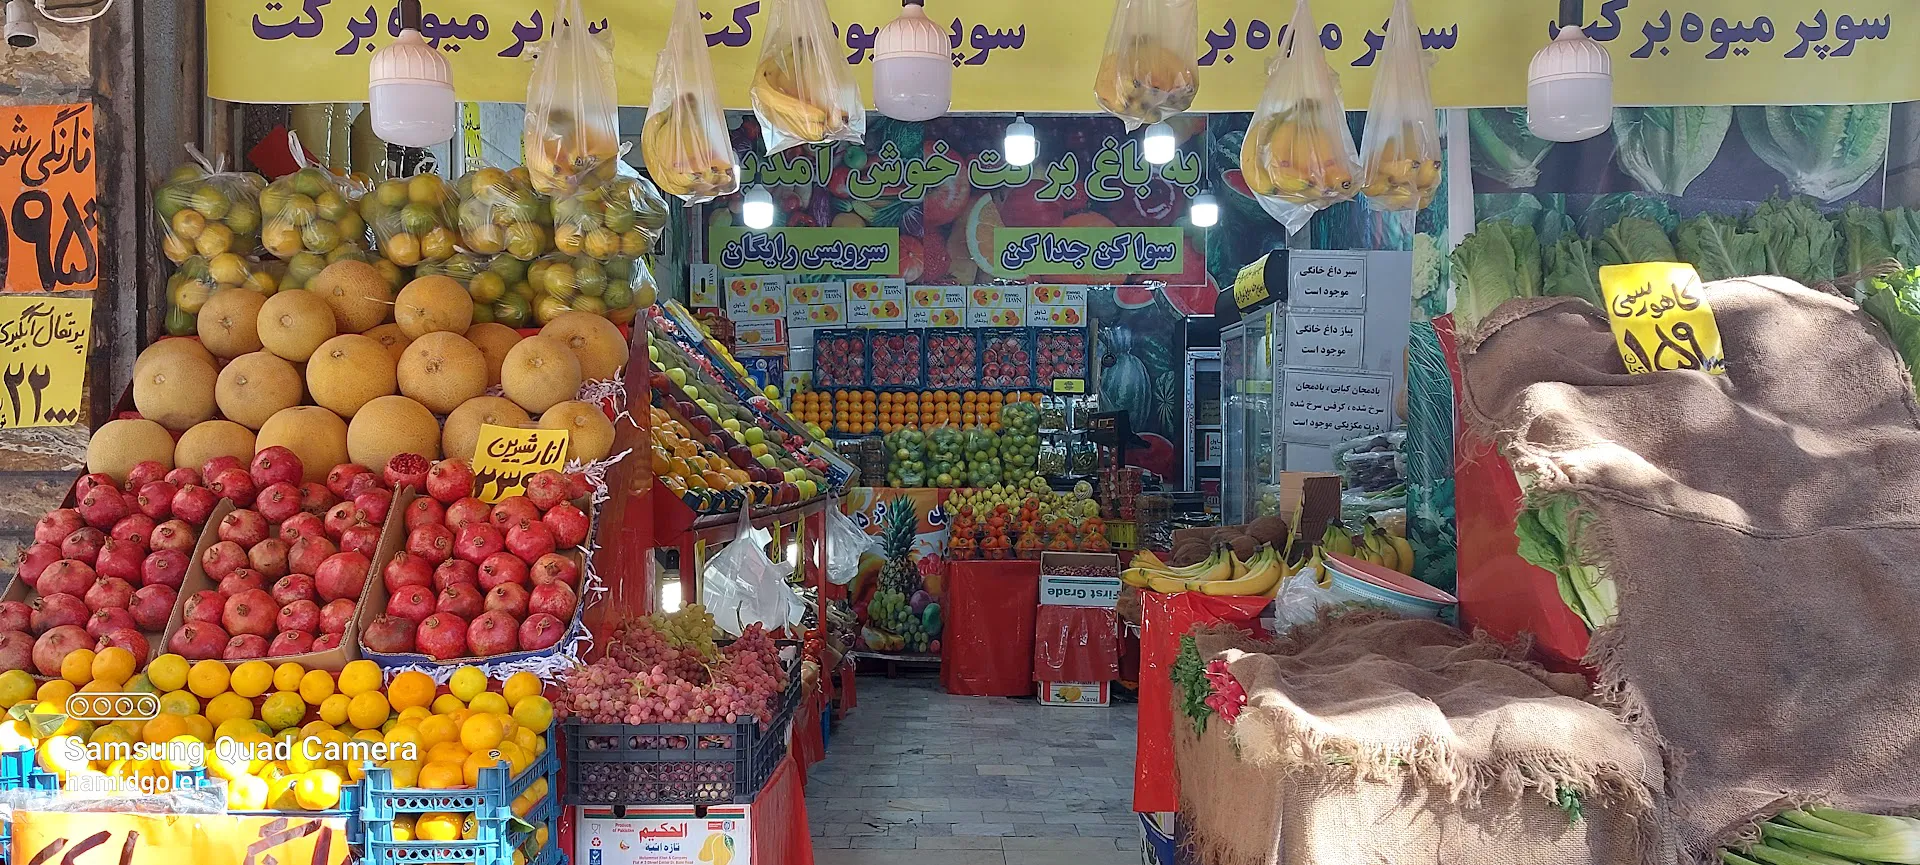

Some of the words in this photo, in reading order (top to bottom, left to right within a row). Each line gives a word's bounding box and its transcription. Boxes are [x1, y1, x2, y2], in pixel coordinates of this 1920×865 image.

[251, 0, 379, 56] برکت
[1549, 0, 1673, 59] برک
[1783, 8, 1892, 60] سوپر
[1680, 11, 1776, 60] میوه
[949, 17, 1027, 68] سوپ
[20, 104, 92, 187] نارنگی
[739, 139, 841, 195] آمدی
[848, 139, 960, 200] خوش
[1085, 135, 1152, 201] باغ
[1161, 148, 1203, 198] به
[721, 231, 799, 271] رایگان
[801, 240, 890, 271] سرویس
[1001, 232, 1041, 271] کن
[1042, 232, 1090, 270] جدا
[1091, 232, 1131, 270] کن
[1132, 232, 1176, 270] سوا
[1299, 265, 1325, 277] خانگی
[1326, 265, 1342, 278] داغ
[1343, 269, 1358, 278] سیر
[1304, 286, 1322, 295] است
[1323, 288, 1349, 298] موجود
[32, 311, 85, 355] پرتقال
[1295, 324, 1321, 335] خانگی
[1323, 324, 1338, 336] داغ
[1339, 325, 1354, 338] پیاز
[1301, 345, 1319, 354] است
[1320, 347, 1346, 357] موجود
[1295, 381, 1325, 393] بادمجان
[1351, 385, 1380, 396] بادمجان
[1289, 399, 1305, 408] شده
[1306, 400, 1322, 411] سرخ
[1323, 401, 1346, 413] کرفس
[1368, 404, 1385, 414] سرخ
[1292, 418, 1309, 426] است
[1309, 420, 1333, 430] موجود
[1334, 421, 1363, 431] مکزیکی
[1363, 424, 1380, 433] ذرت
[486, 432, 538, 464] شیرین
[521, 437, 566, 466] انار
[1047, 588, 1087, 599] Grade
[1090, 589, 1120, 600] First
